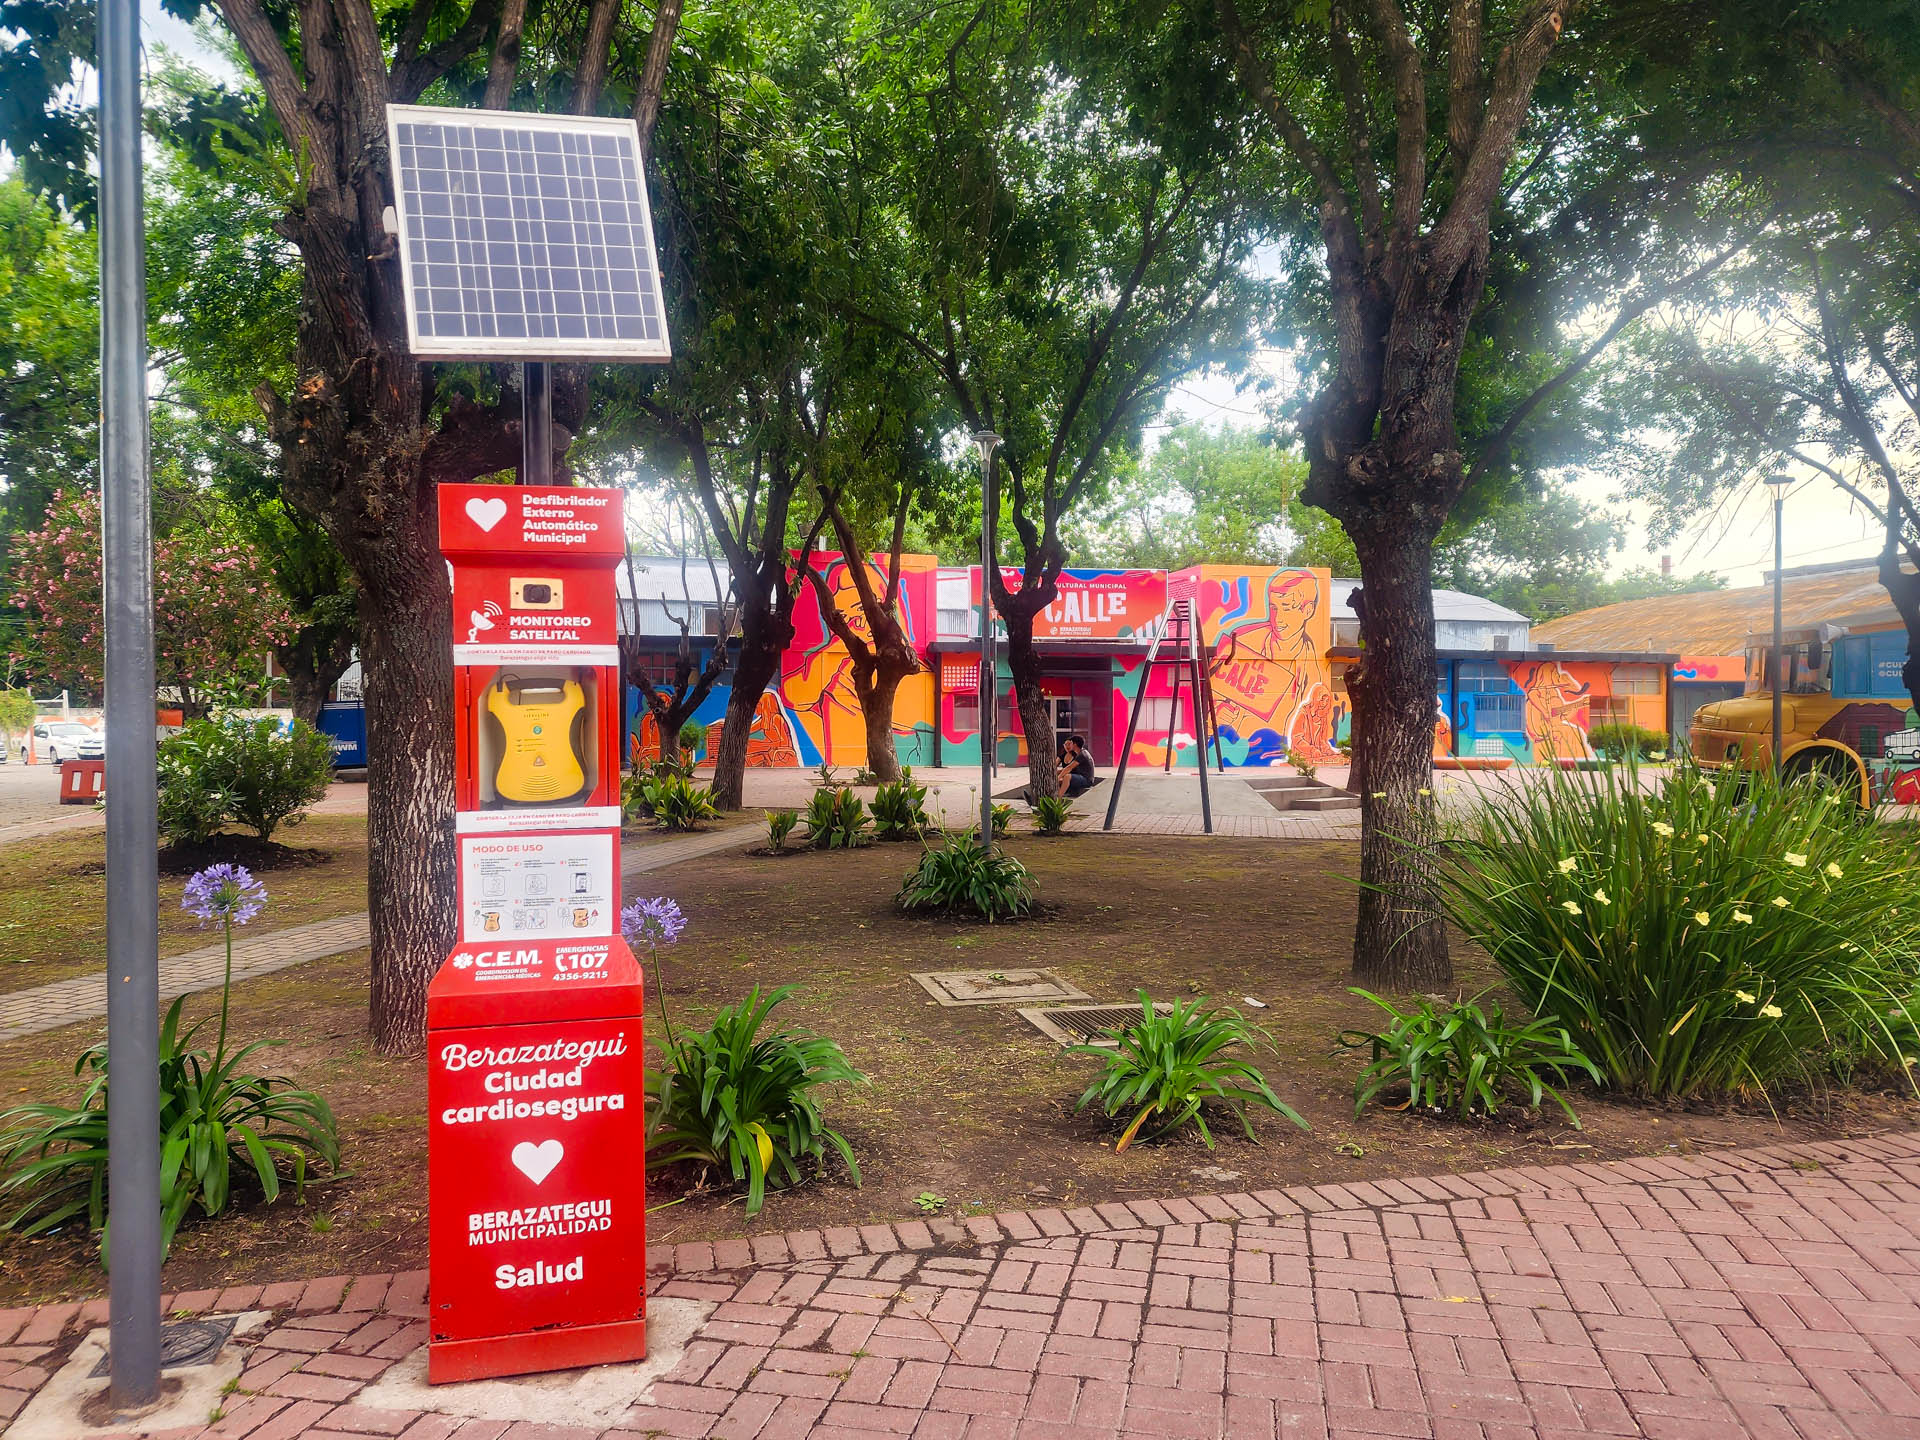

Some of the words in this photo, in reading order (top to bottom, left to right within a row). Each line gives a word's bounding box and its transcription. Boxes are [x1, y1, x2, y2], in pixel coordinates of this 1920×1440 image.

[522, 494, 608, 507] Desfibrilador
[522, 507, 575, 518] Externo
[522, 519, 599, 531] Automático
[523, 532, 587, 545] Municipal
[1089, 582, 1127, 590] MUNICIPAL
[510, 616, 592, 627] MONITOREO
[510, 629, 581, 641] SATELITAL
[472, 845, 505, 854] MODO
[506, 845, 520, 853] DE
[522, 844, 544, 852] USO
[556, 945, 609, 954] EMERGENCIAS
[475, 950, 543, 968] C.E.M.
[568, 953, 609, 970] 107
[552, 970, 608, 981] 4356-9215
[441, 1032, 628, 1071] Berazategui
[484, 1066, 582, 1093] Ciudad
[442, 1094, 624, 1125] cardiosegura
[469, 1199, 612, 1231] BERAZATEGUI
[469, 1217, 612, 1246] MUNICIPALIDAD
[495, 1256, 584, 1290] Salud
